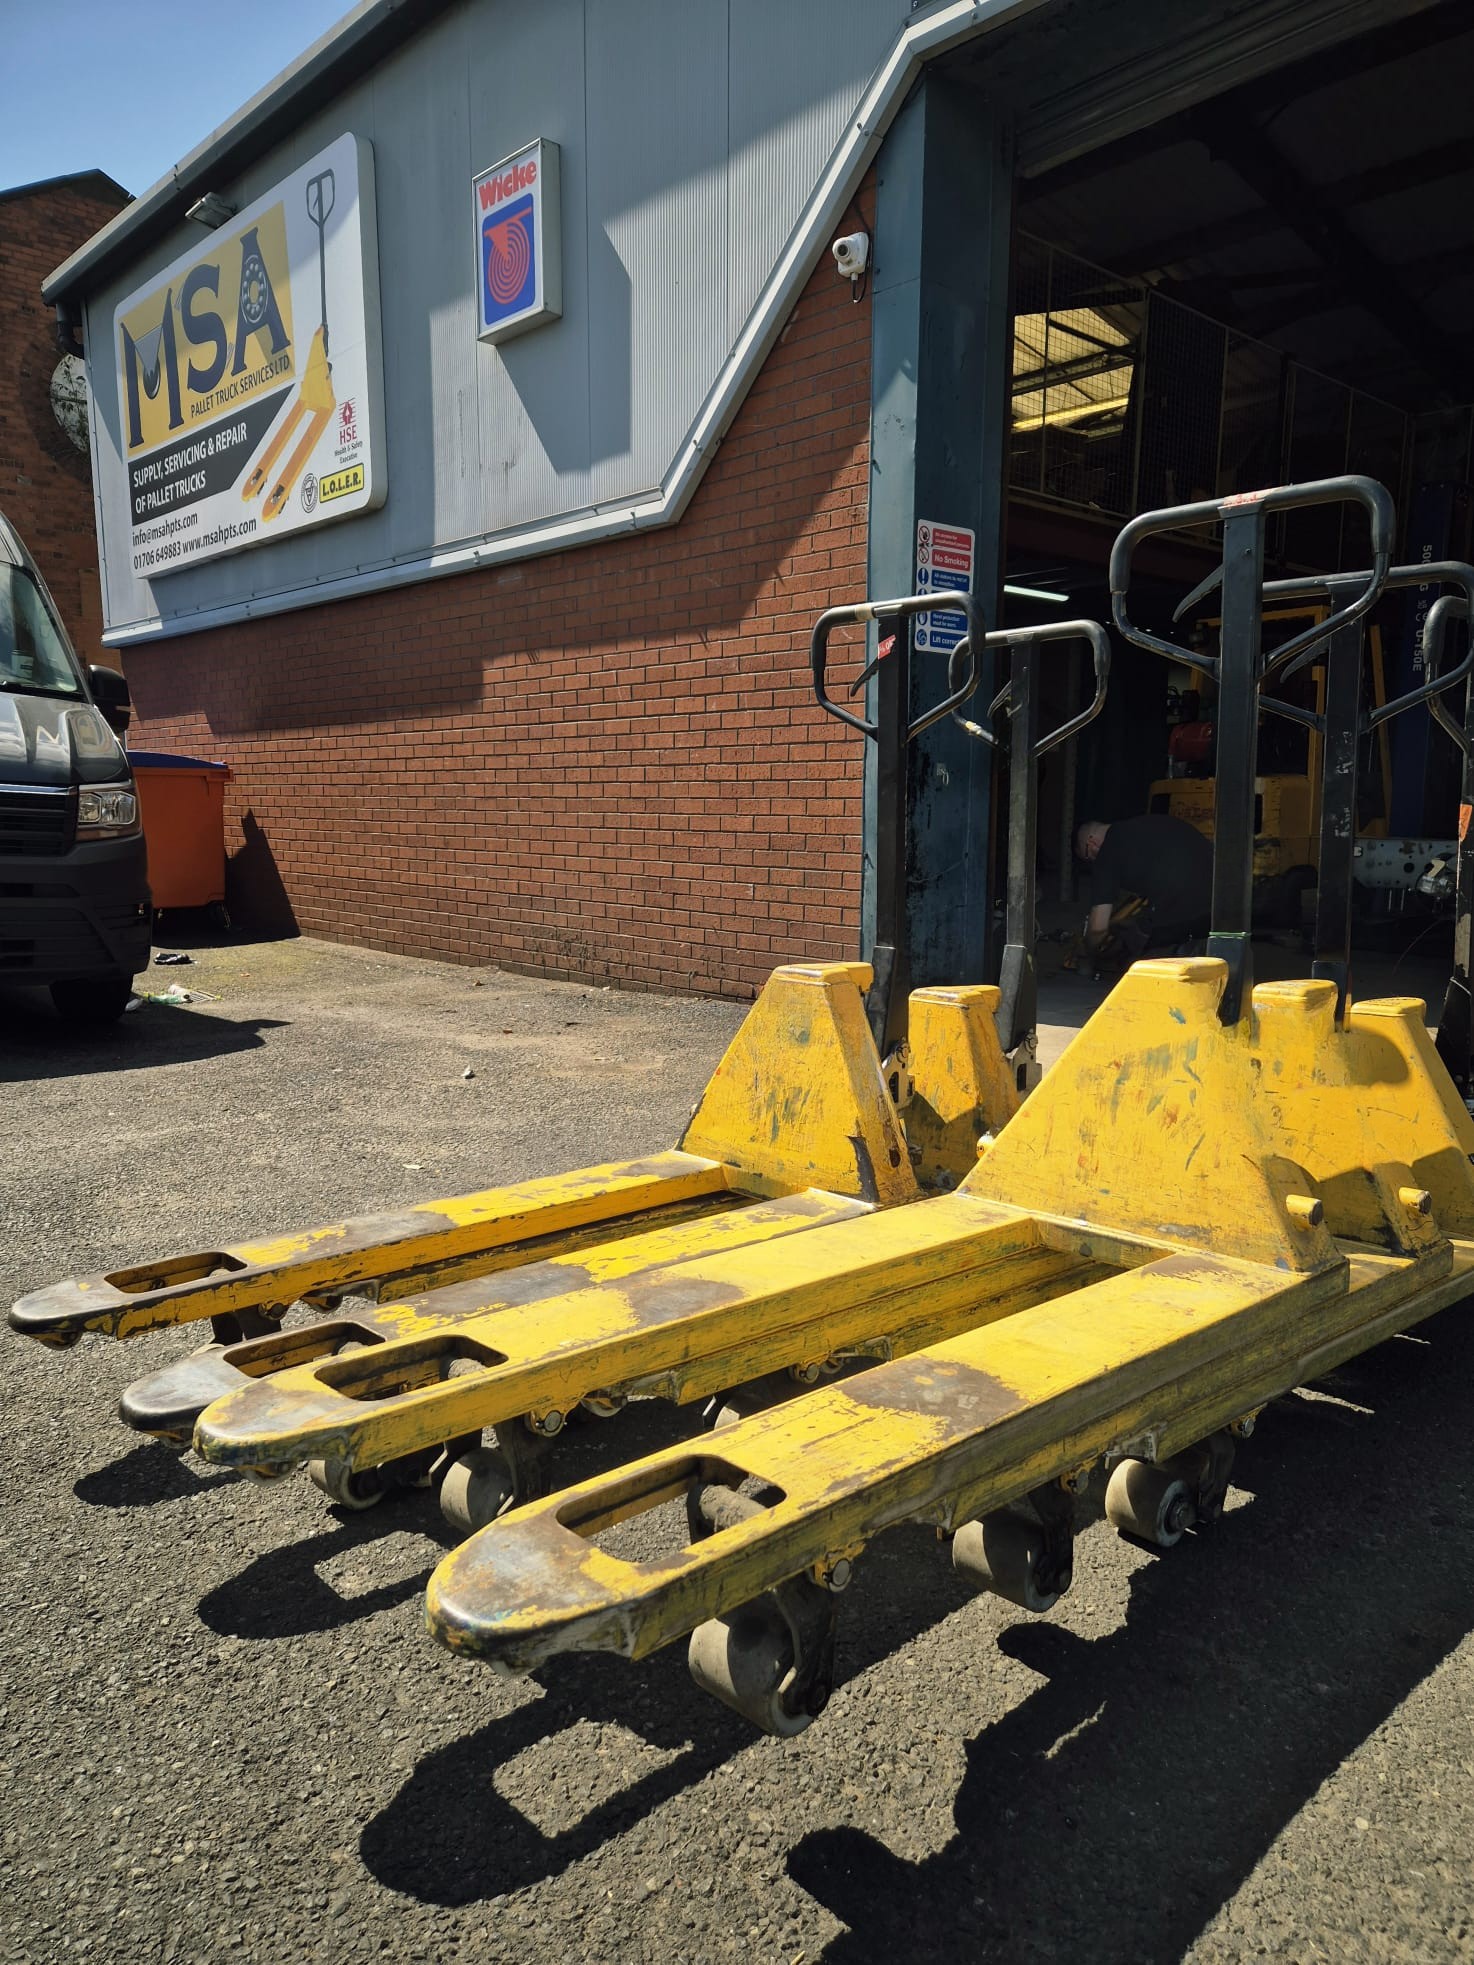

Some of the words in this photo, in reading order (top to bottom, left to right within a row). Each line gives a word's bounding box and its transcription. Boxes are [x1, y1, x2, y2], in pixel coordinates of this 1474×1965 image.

[478, 160, 537, 212] Wicke
[120, 226, 292, 449] MSA
[190, 395, 214, 418] PALLET
[215, 381, 239, 406] TRUCK
[239, 362, 275, 394] SERVICES
[274, 354, 290, 376] LTD
[133, 460, 164, 488] SUPPLY,
[164, 440, 207, 475] SERVICING
[207, 437, 215, 456] &
[215, 422, 247, 453] REPAIR
[339, 424, 358, 445] HSE
[135, 495, 147, 514] OF
[146, 482, 174, 510] PALLET
[174, 470, 206, 499] TRUCKS
[322, 472, 362, 497] L.O.L.E.R.
[132, 512, 198, 547] info@msahpts.com
[133, 549, 155, 570] 01706
[155, 541, 181, 562] 649883
[182, 518, 257, 554] www.msahpts.com
[934, 553, 943, 562] No
[943, 555, 969, 569] Smoking
[932, 634, 942, 644] Lift
